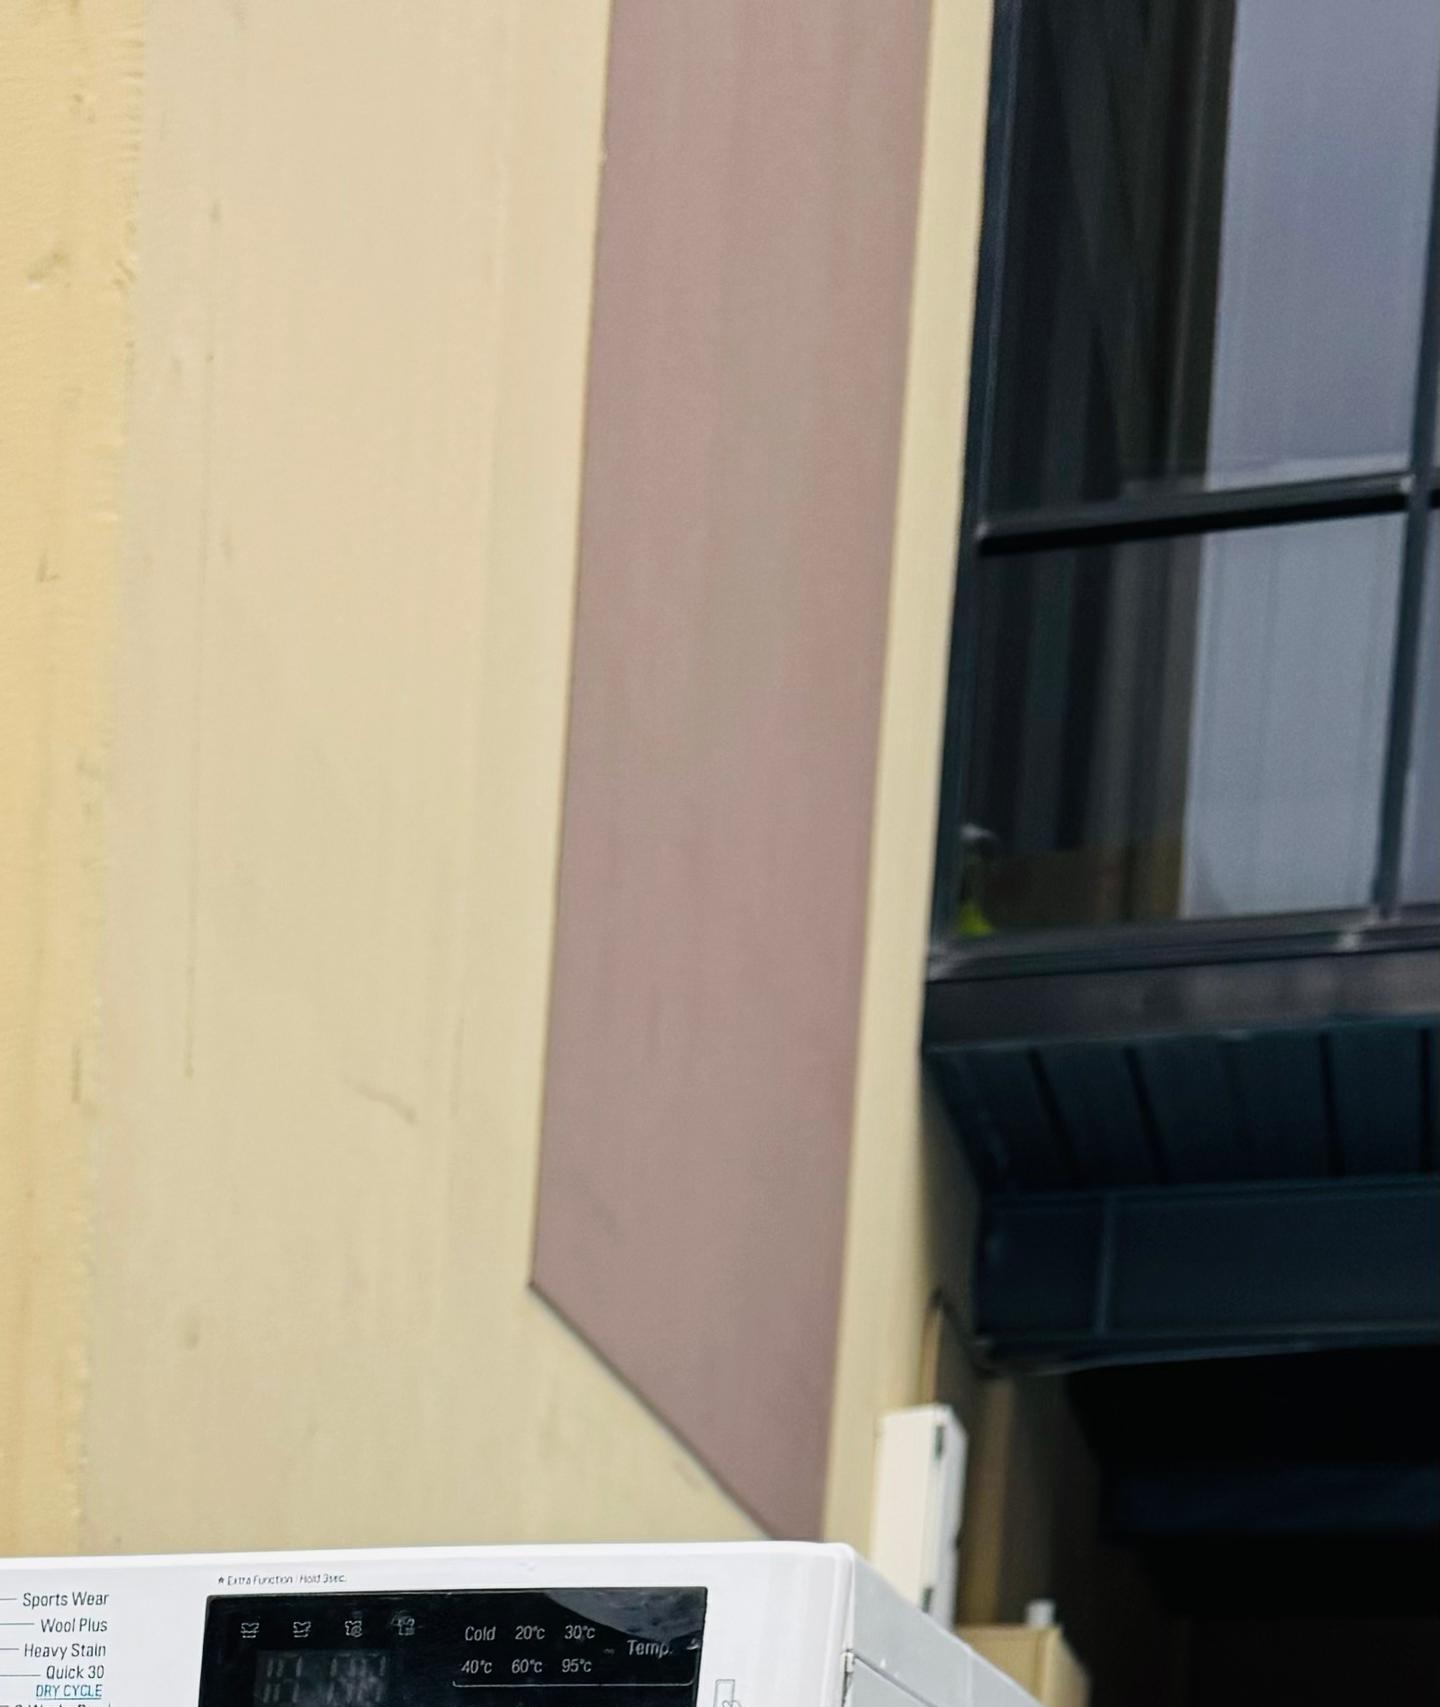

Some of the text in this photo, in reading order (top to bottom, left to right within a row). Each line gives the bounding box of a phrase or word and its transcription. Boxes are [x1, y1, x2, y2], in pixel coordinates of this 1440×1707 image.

[23, 1591, 110, 1610] Sports Wear
[40, 1617, 108, 1633] Wool Plus
[465, 1626, 496, 1641] Cold
[23, 1643, 107, 1660] Heavy Stain
[627, 1640, 672, 1658] Temp.
[46, 1665, 104, 1681] Quick 30
[36, 1684, 102, 1698] DRY CYCLE
